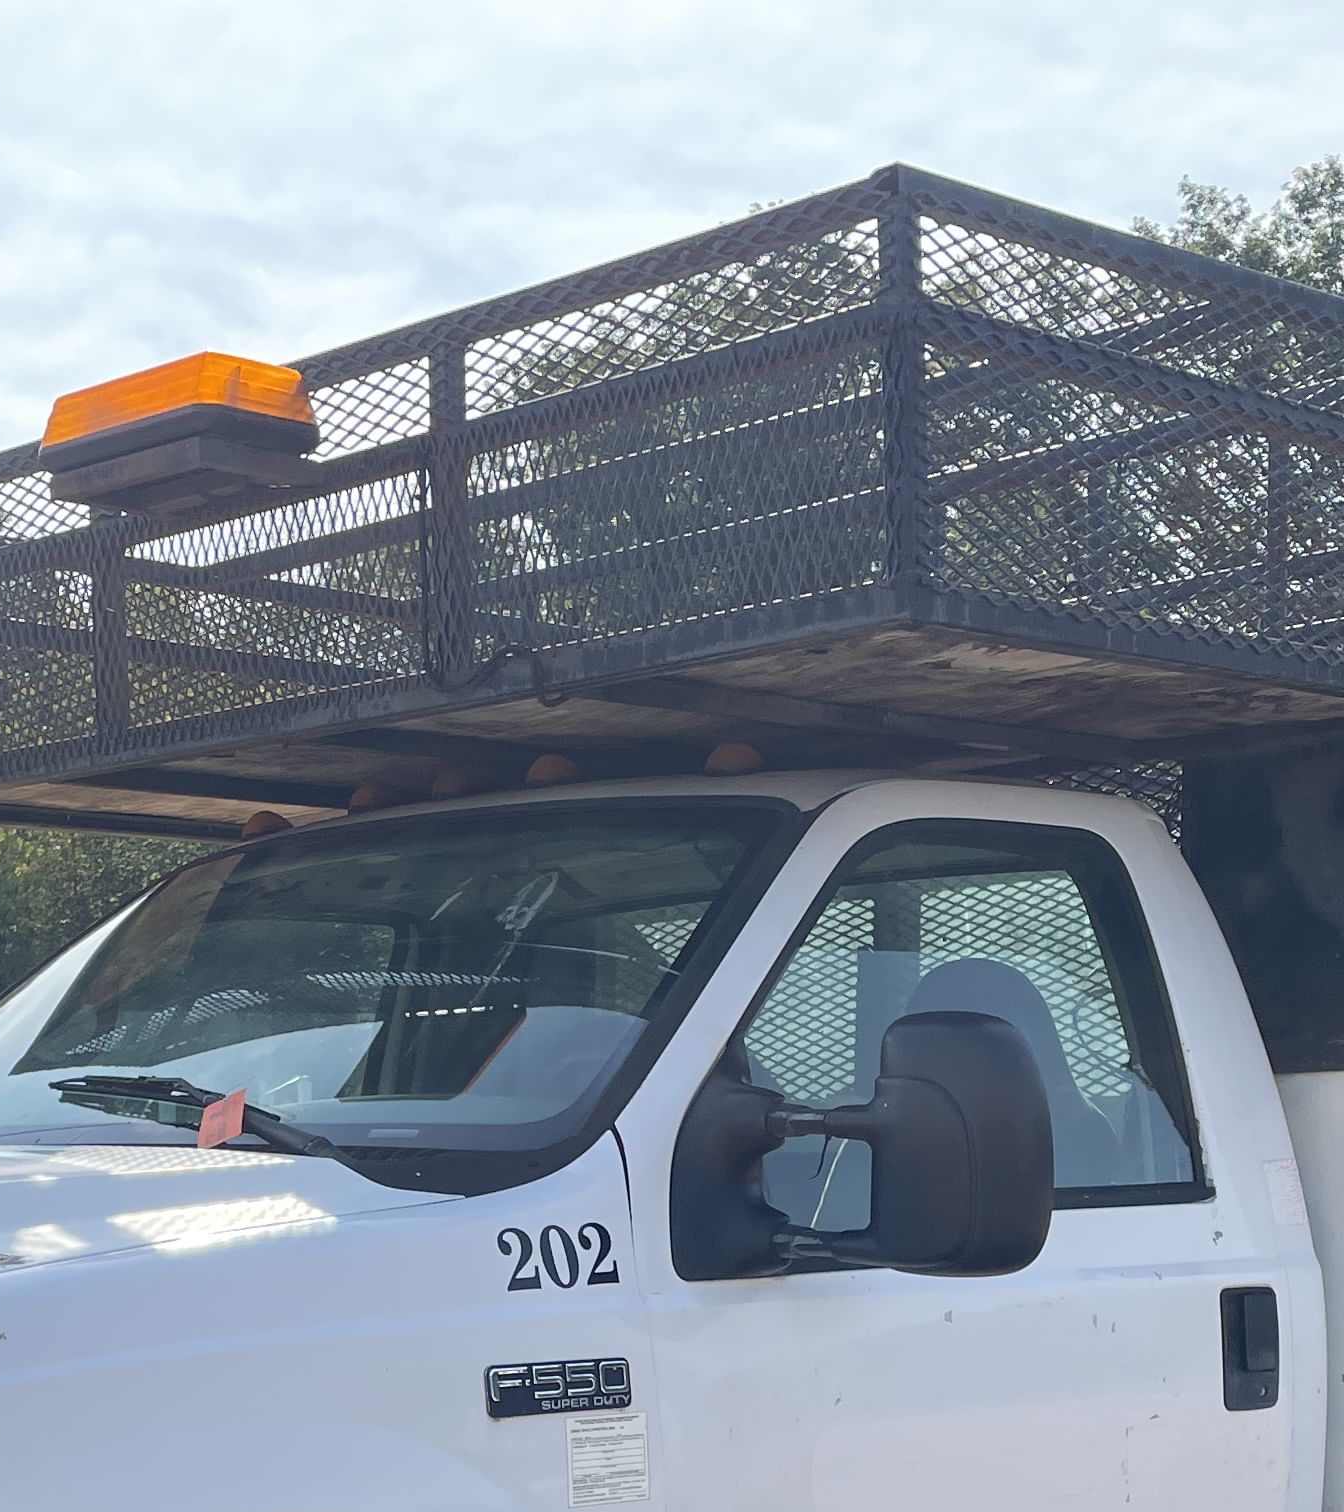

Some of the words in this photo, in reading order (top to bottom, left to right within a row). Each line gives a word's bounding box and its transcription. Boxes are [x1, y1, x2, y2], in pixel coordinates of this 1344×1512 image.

[497, 1222, 620, 1292] 202
[541, 1398, 589, 1411] SUPER
[593, 1394, 630, 1407] DUTY
